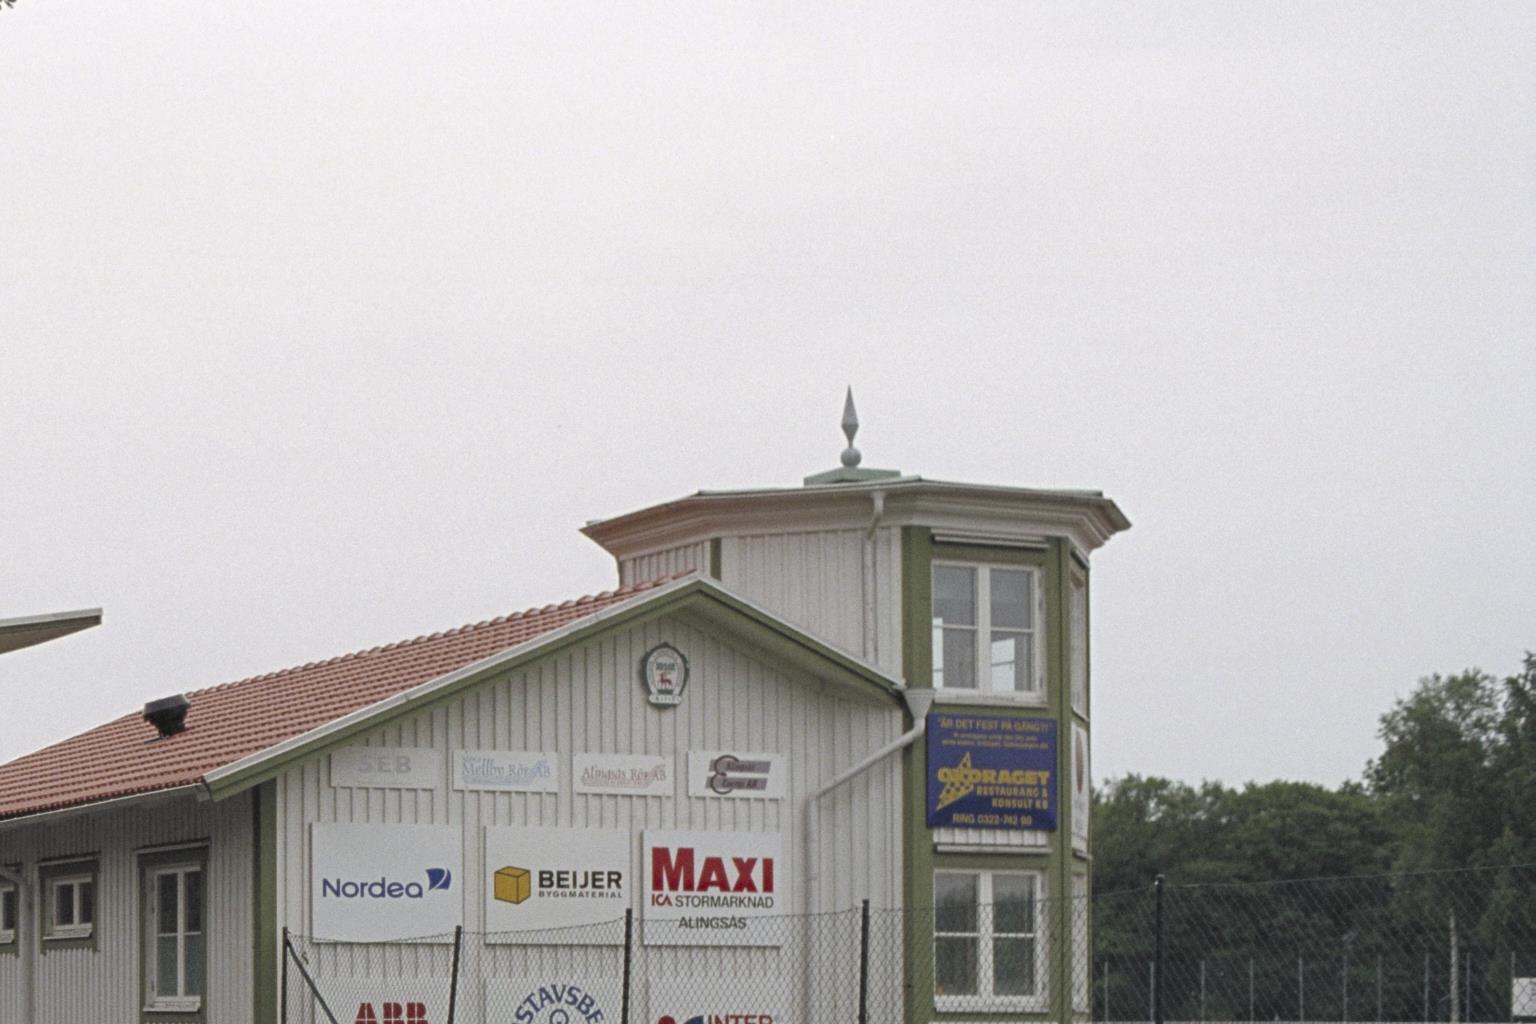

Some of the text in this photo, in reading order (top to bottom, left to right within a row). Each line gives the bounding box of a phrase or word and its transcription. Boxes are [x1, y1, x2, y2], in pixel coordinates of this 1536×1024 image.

[359, 755, 411, 774] SEB
[976, 786, 1040, 797] RESTAURANG
[652, 847, 774, 893] MAXI
[322, 876, 424, 898] Nordea
[538, 870, 623, 890] BEIJER
[538, 890, 623, 899] BYGGMATERIAL
[651, 894, 775, 909] ICA STORMARKNAD
[678, 914, 748, 930] ALINGSÅS
